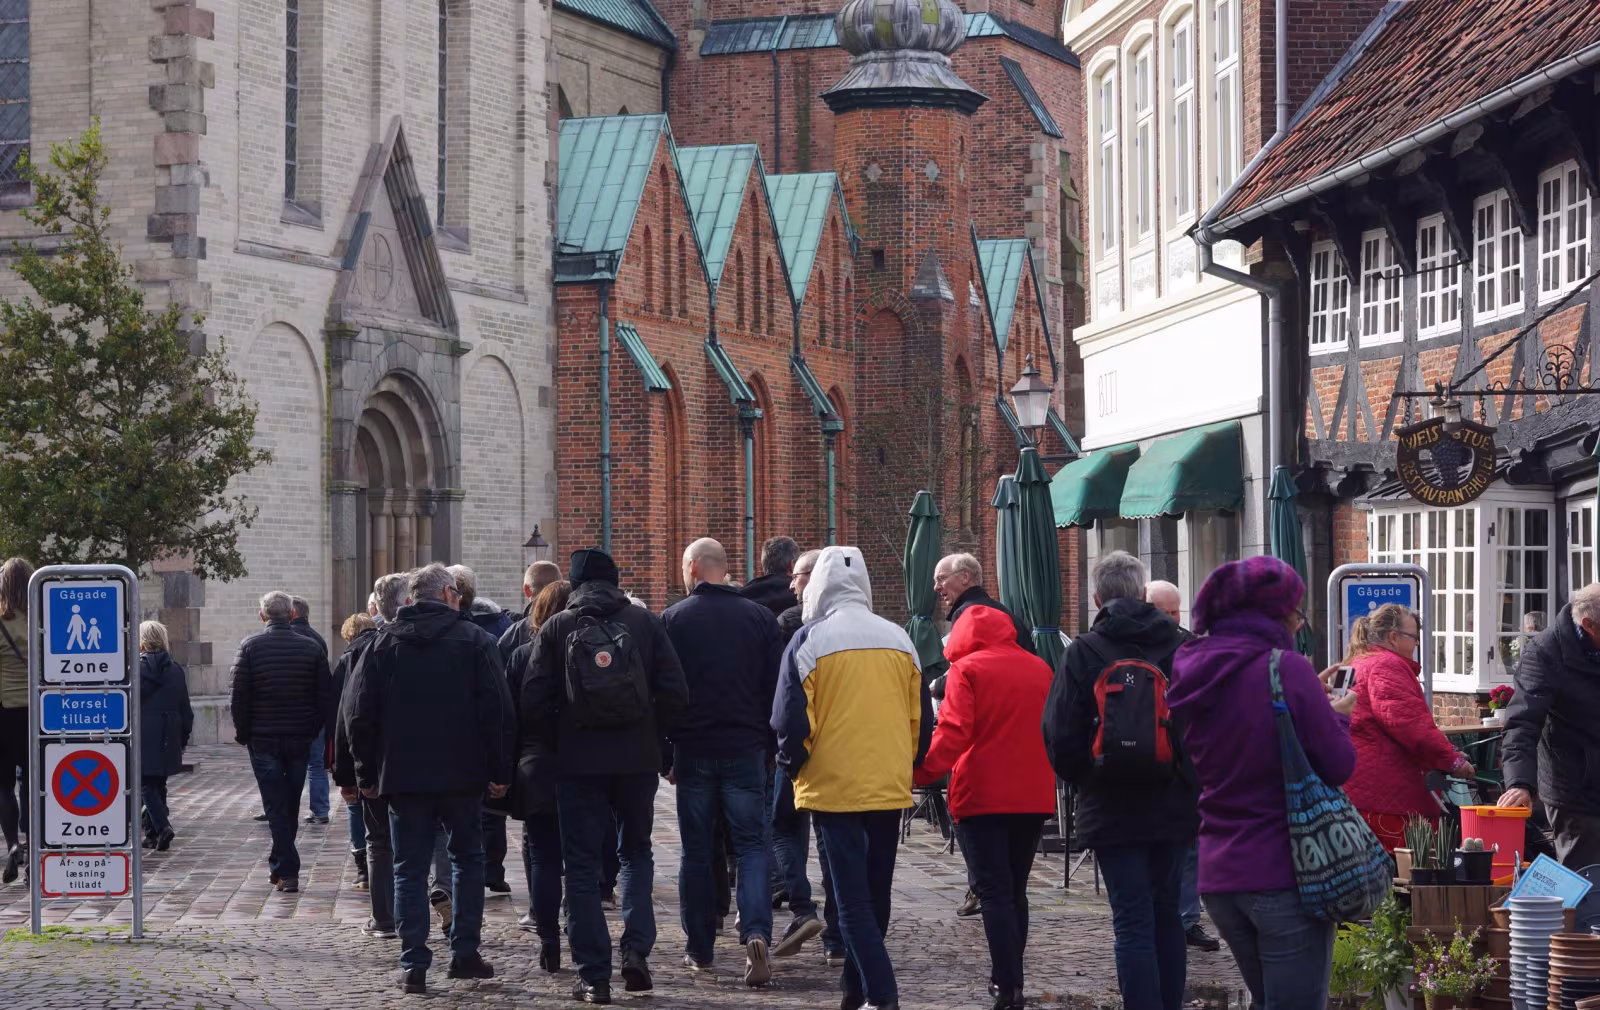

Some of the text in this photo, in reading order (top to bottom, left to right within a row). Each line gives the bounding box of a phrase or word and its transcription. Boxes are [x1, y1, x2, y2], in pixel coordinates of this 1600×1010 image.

[60, 590, 107, 601] Gågade
[1357, 587, 1401, 597] Gågade
[60, 660, 108, 673] Zone
[62, 698, 107, 709] Kørsel
[62, 713, 106, 724] tilladt
[62, 822, 109, 836] Zone
[94, 859, 111, 867] på-
[66, 870, 105, 878] læsning
